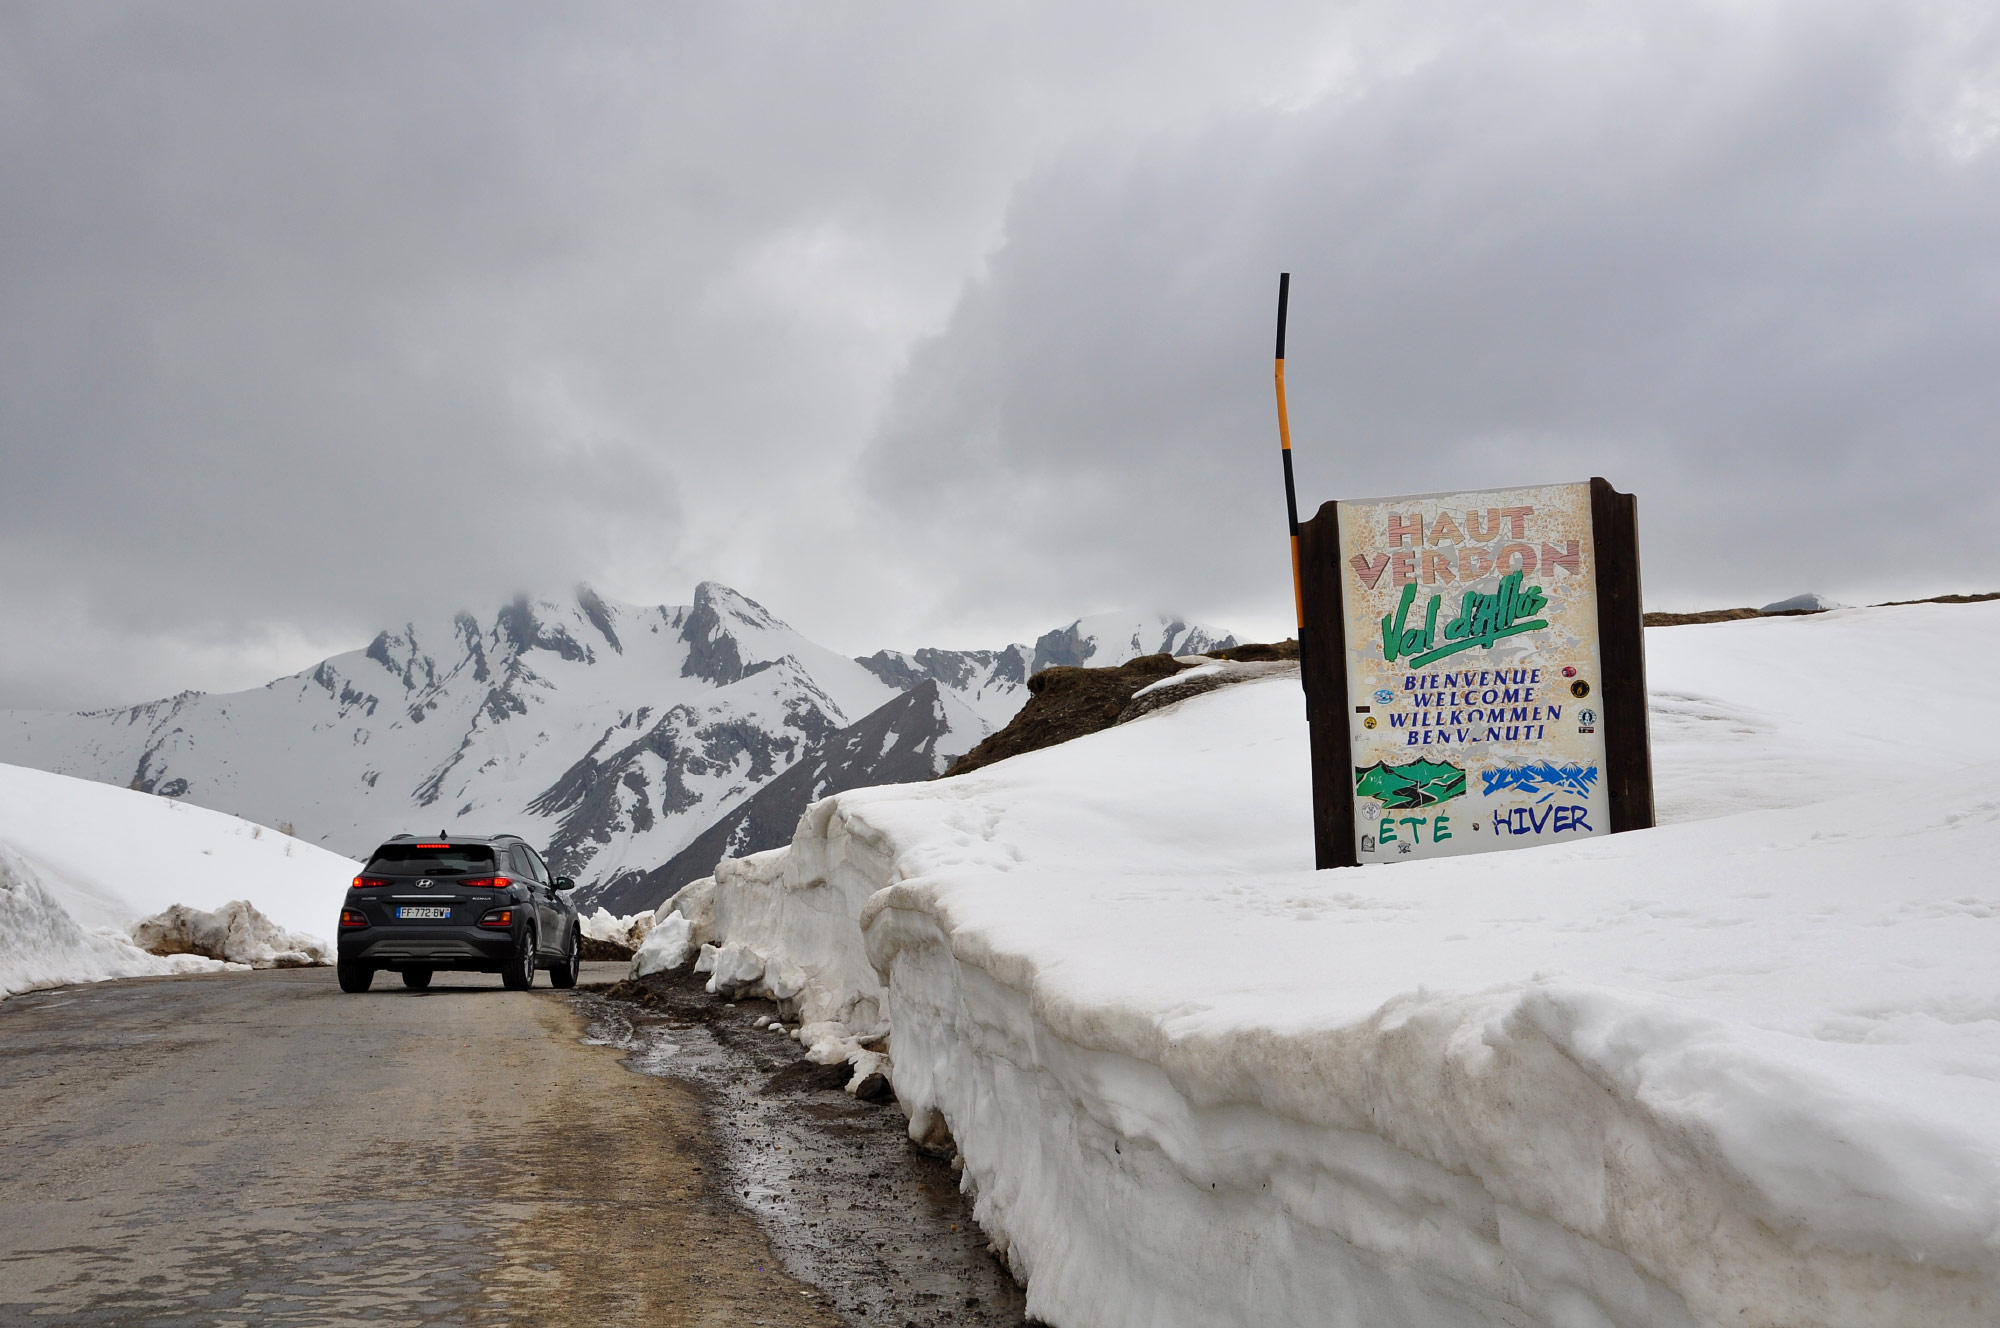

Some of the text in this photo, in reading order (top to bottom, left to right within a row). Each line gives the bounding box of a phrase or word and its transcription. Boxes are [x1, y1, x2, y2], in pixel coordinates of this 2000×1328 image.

[1387, 505, 1534, 548] HAUT
[1349, 539, 1580, 590] VERDON
[1381, 583, 1442, 663] Val
[1404, 668, 1541, 691] BIENVENUE
[1413, 687, 1535, 708] WELCOME
[1389, 704, 1562, 728] WILLKOMMEN
[1407, 724, 1545, 746] BENVNUTI
[1378, 810, 1453, 845] ÉTÉ
[1492, 803, 1593, 836] HIVER
